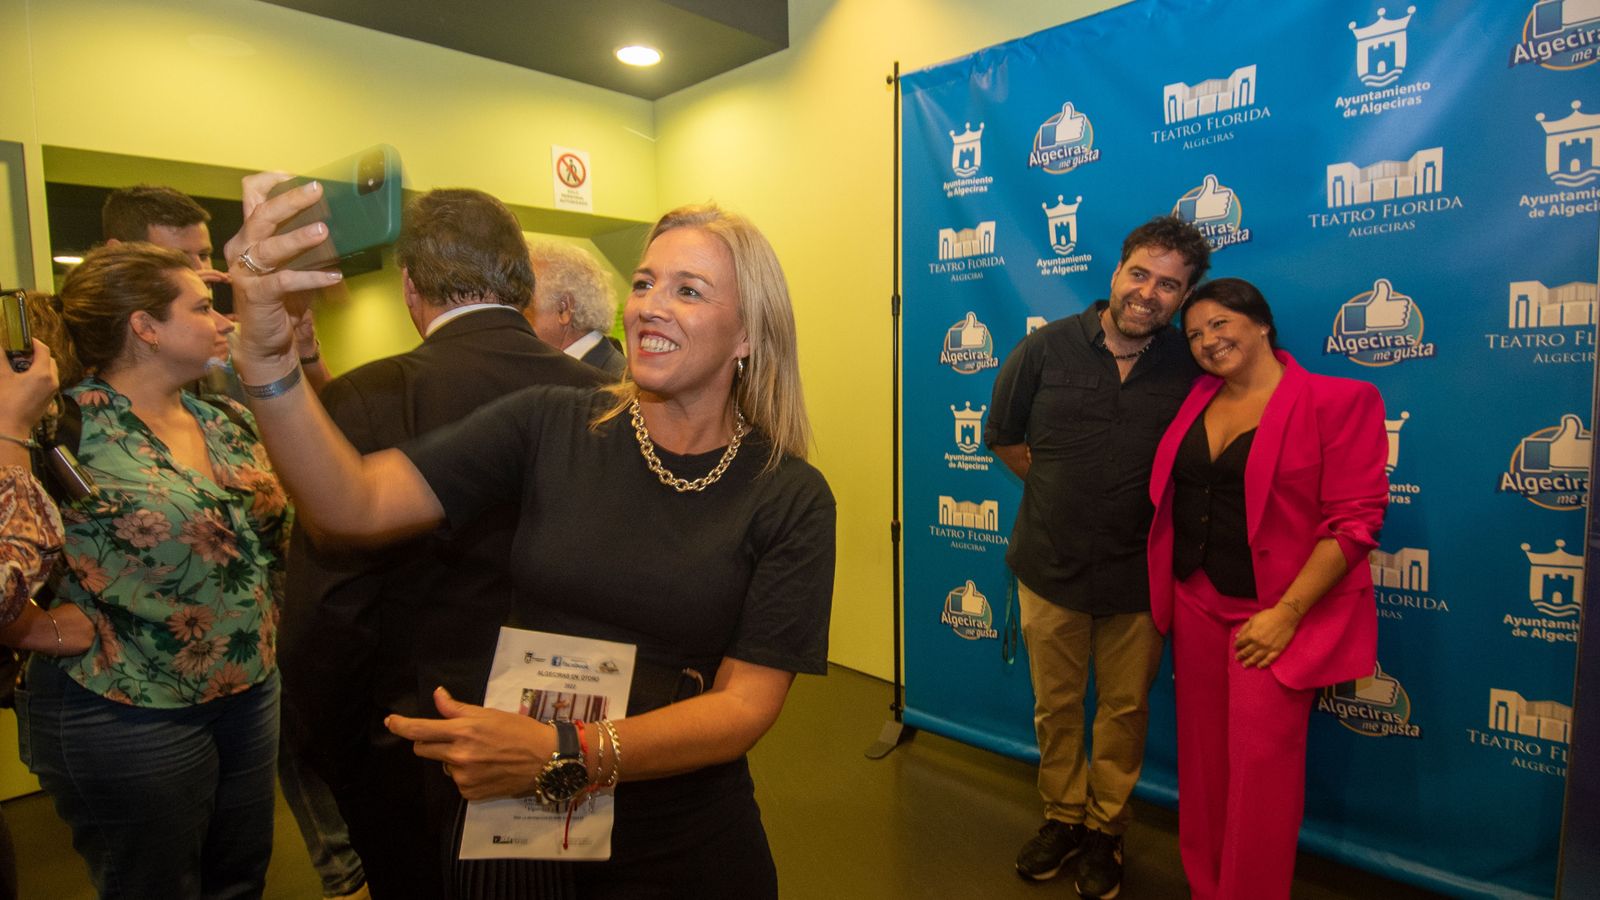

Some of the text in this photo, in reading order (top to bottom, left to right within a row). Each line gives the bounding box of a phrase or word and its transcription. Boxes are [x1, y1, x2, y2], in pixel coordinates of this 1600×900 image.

[1513, 28, 1600, 64] Algecir
[1571, 48, 1592, 63] me
[1335, 81, 1431, 108] Ayuntamiento
[1343, 95, 1422, 118] de Algeciras
[1152, 106, 1272, 144] TEATRO FLORIDA
[1183, 132, 1235, 150] ALGECIRAS
[1029, 144, 1089, 166] Algeciras
[1072, 149, 1099, 168] gusta
[943, 176, 994, 191] Ayuntamiento
[953, 186, 988, 197] Algeciras
[1308, 195, 1463, 228] TEATRO FLORIDA
[1528, 199, 1600, 218] de Algeci
[1198, 222, 1235, 237] ciras
[1349, 219, 1415, 237] ALGECIRAS
[1217, 228, 1250, 248] gusta
[929, 256, 1006, 274] TEATRO FLORIDA
[1036, 254, 1092, 268] Ayuntamiento
[1041, 263, 1089, 275] de Algeciras
[1326, 332, 1416, 354] Algeciras
[1484, 333, 1566, 349] TEATRO
[940, 349, 989, 366] Algeciras
[1373, 342, 1435, 363] me gusta
[976, 357, 999, 371] gusta
[944, 452, 994, 463] Ayuntamiento
[957, 461, 989, 471] Algeciras
[1557, 494, 1578, 504] me
[929, 525, 1009, 545] TEATRO FLORIDA
[941, 611, 989, 629] Algeciras
[976, 629, 998, 640] gusta
[1512, 628, 1577, 642] de Algeci
[1318, 697, 1405, 724] Algeciras
[1382, 722, 1420, 737] gusta
[1466, 728, 1541, 756] TEATRO
[1511, 756, 1566, 777] ALGECI
